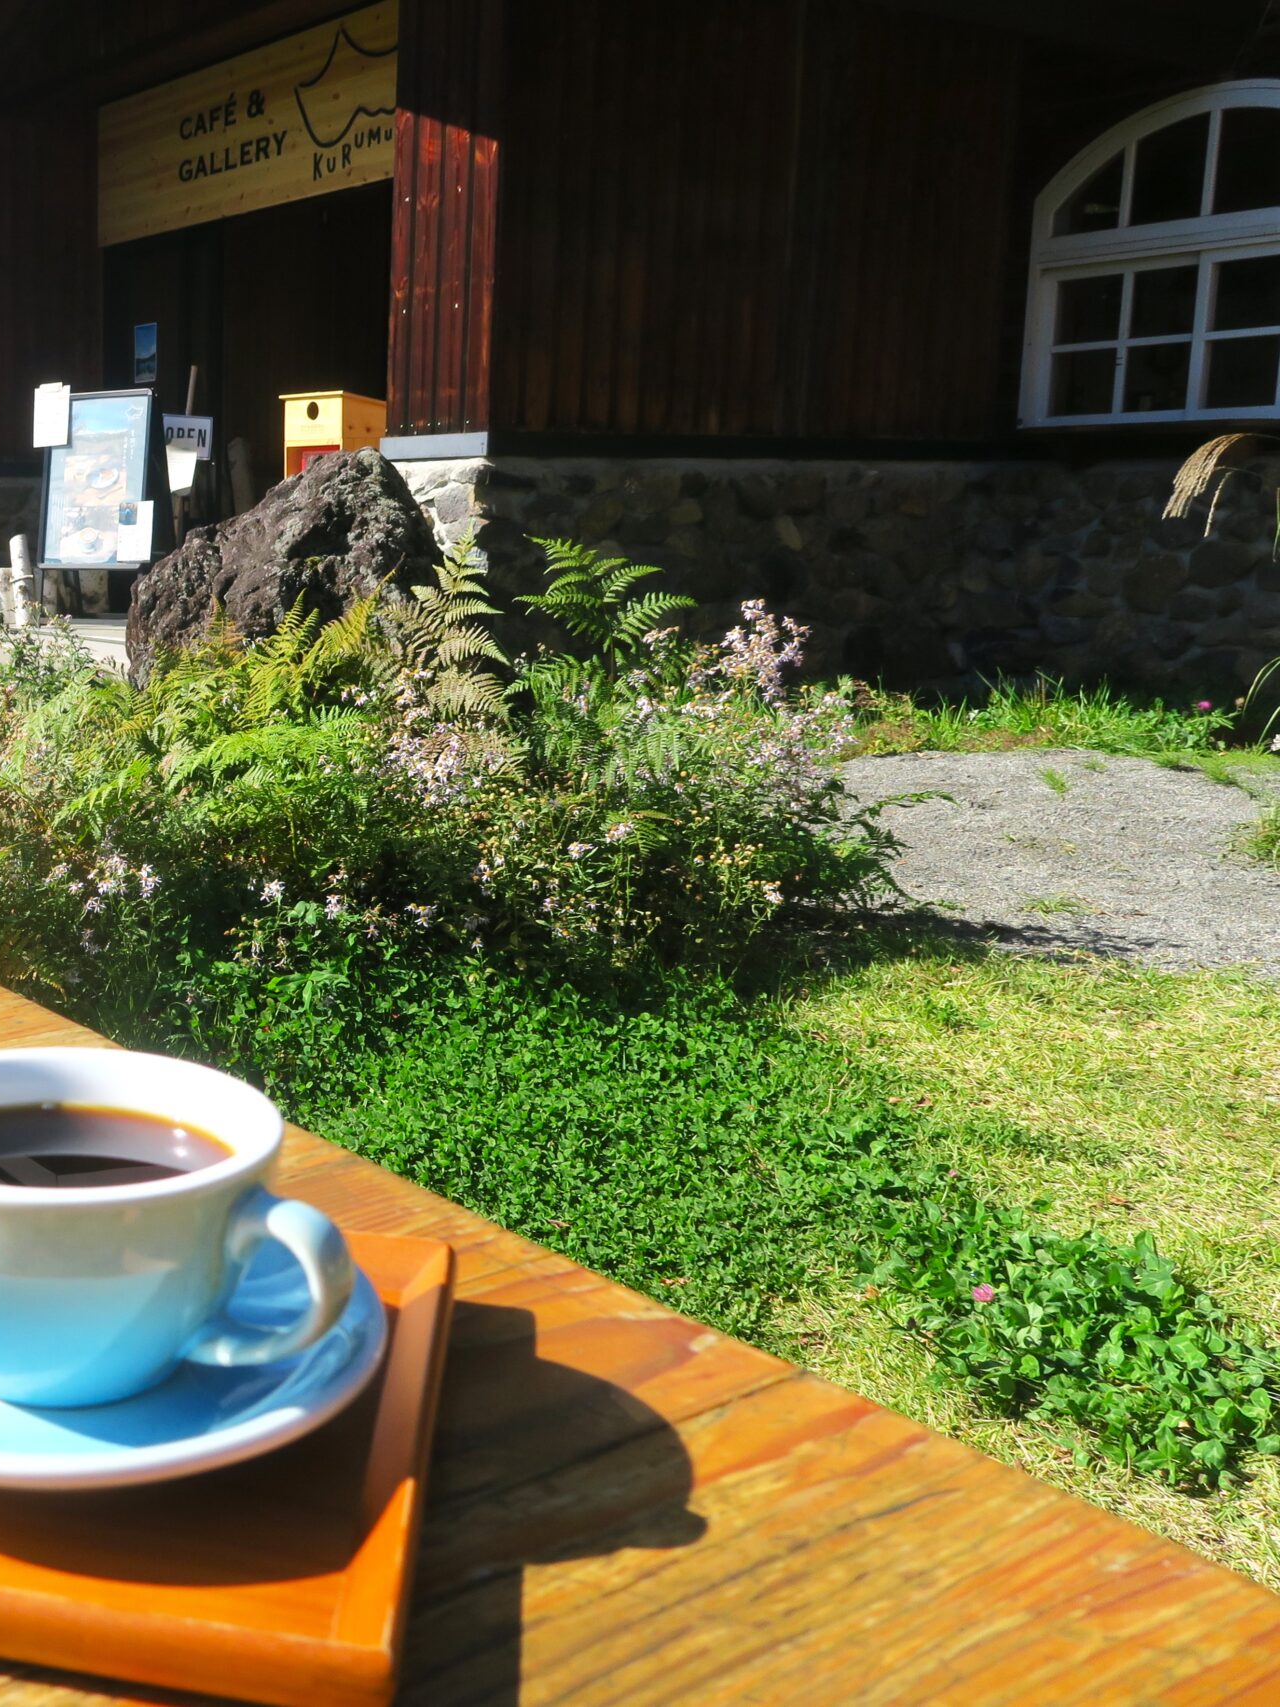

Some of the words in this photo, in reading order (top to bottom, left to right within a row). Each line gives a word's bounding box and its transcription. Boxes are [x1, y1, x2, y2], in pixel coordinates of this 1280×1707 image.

[179, 93, 237, 140] CAFÉ
[246, 89, 266, 119] &
[178, 130, 288, 182] GALLERY
